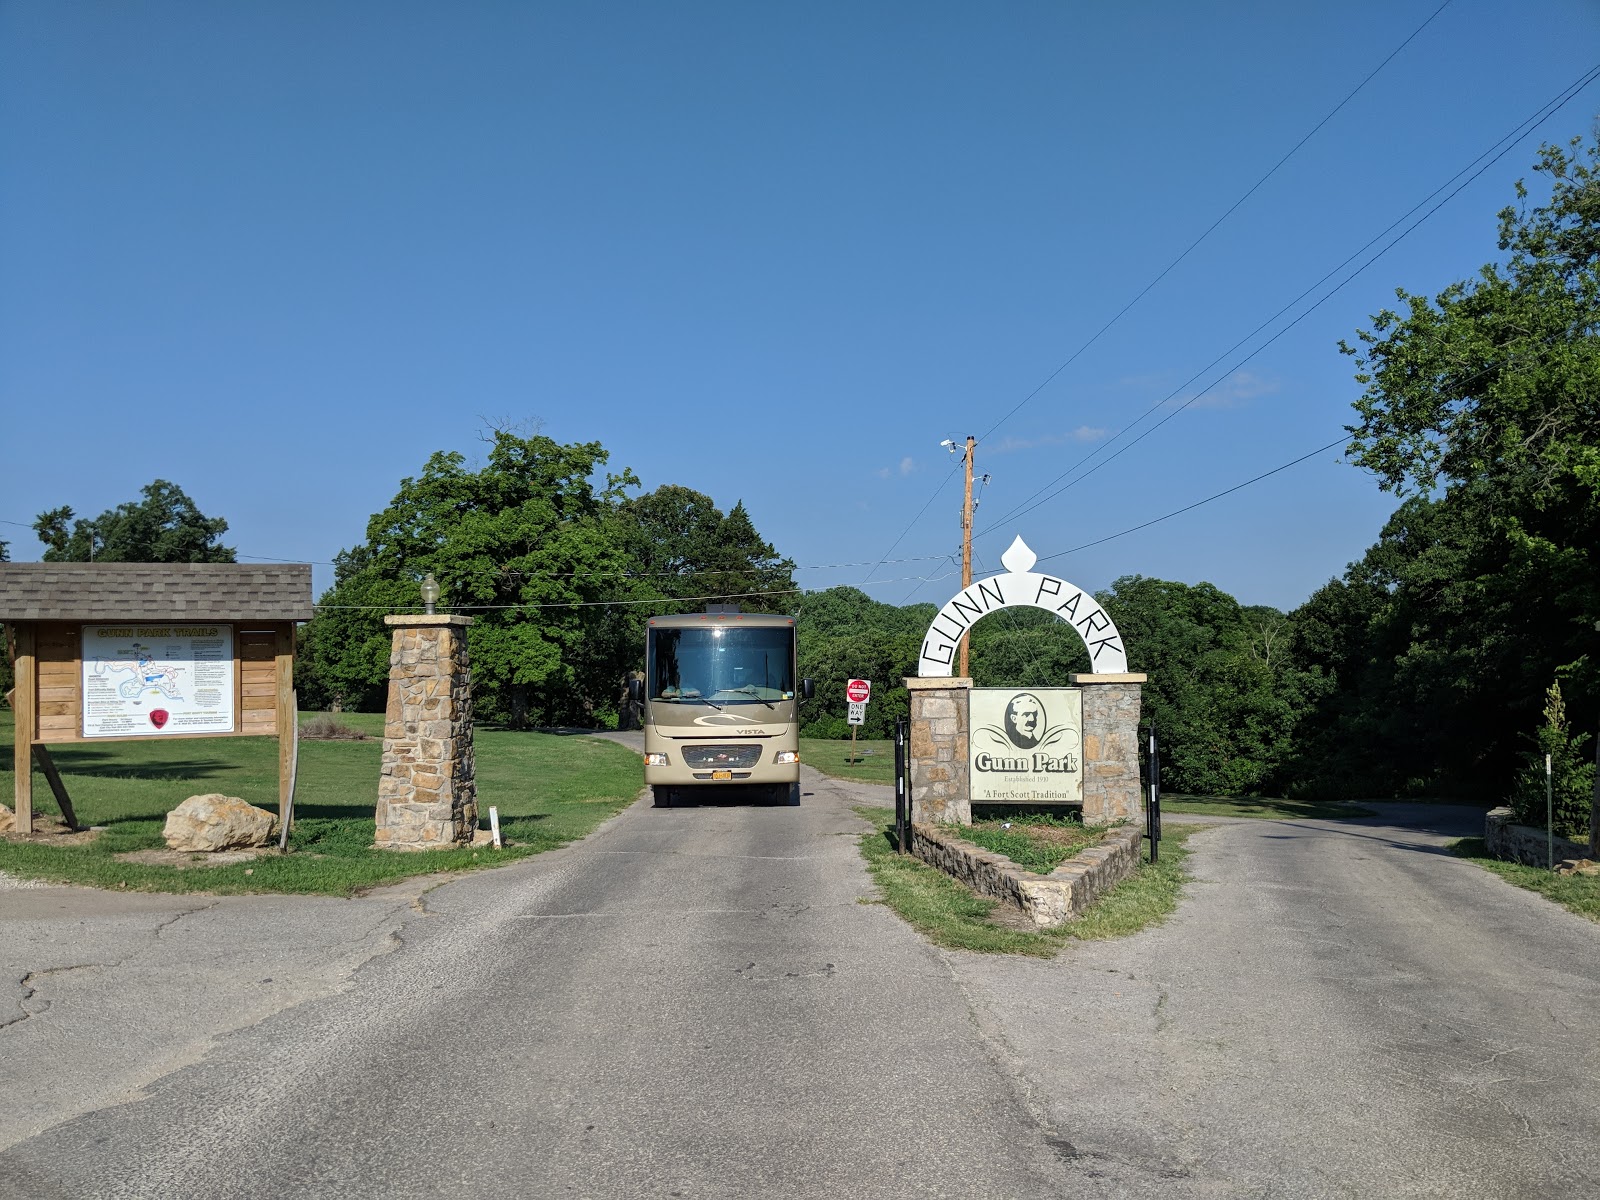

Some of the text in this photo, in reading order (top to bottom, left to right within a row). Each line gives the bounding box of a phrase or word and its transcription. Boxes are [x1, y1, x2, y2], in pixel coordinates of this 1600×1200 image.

[922, 577, 1122, 665] GUNN PARK
[98, 627, 218, 638] GUNN PARK TRAILS
[975, 752, 1078, 773] Gunn Park
[993, 790, 1009, 798] Fort
[1010, 790, 1030, 798] Scott
[1031, 790, 1070, 798] Tradition"
